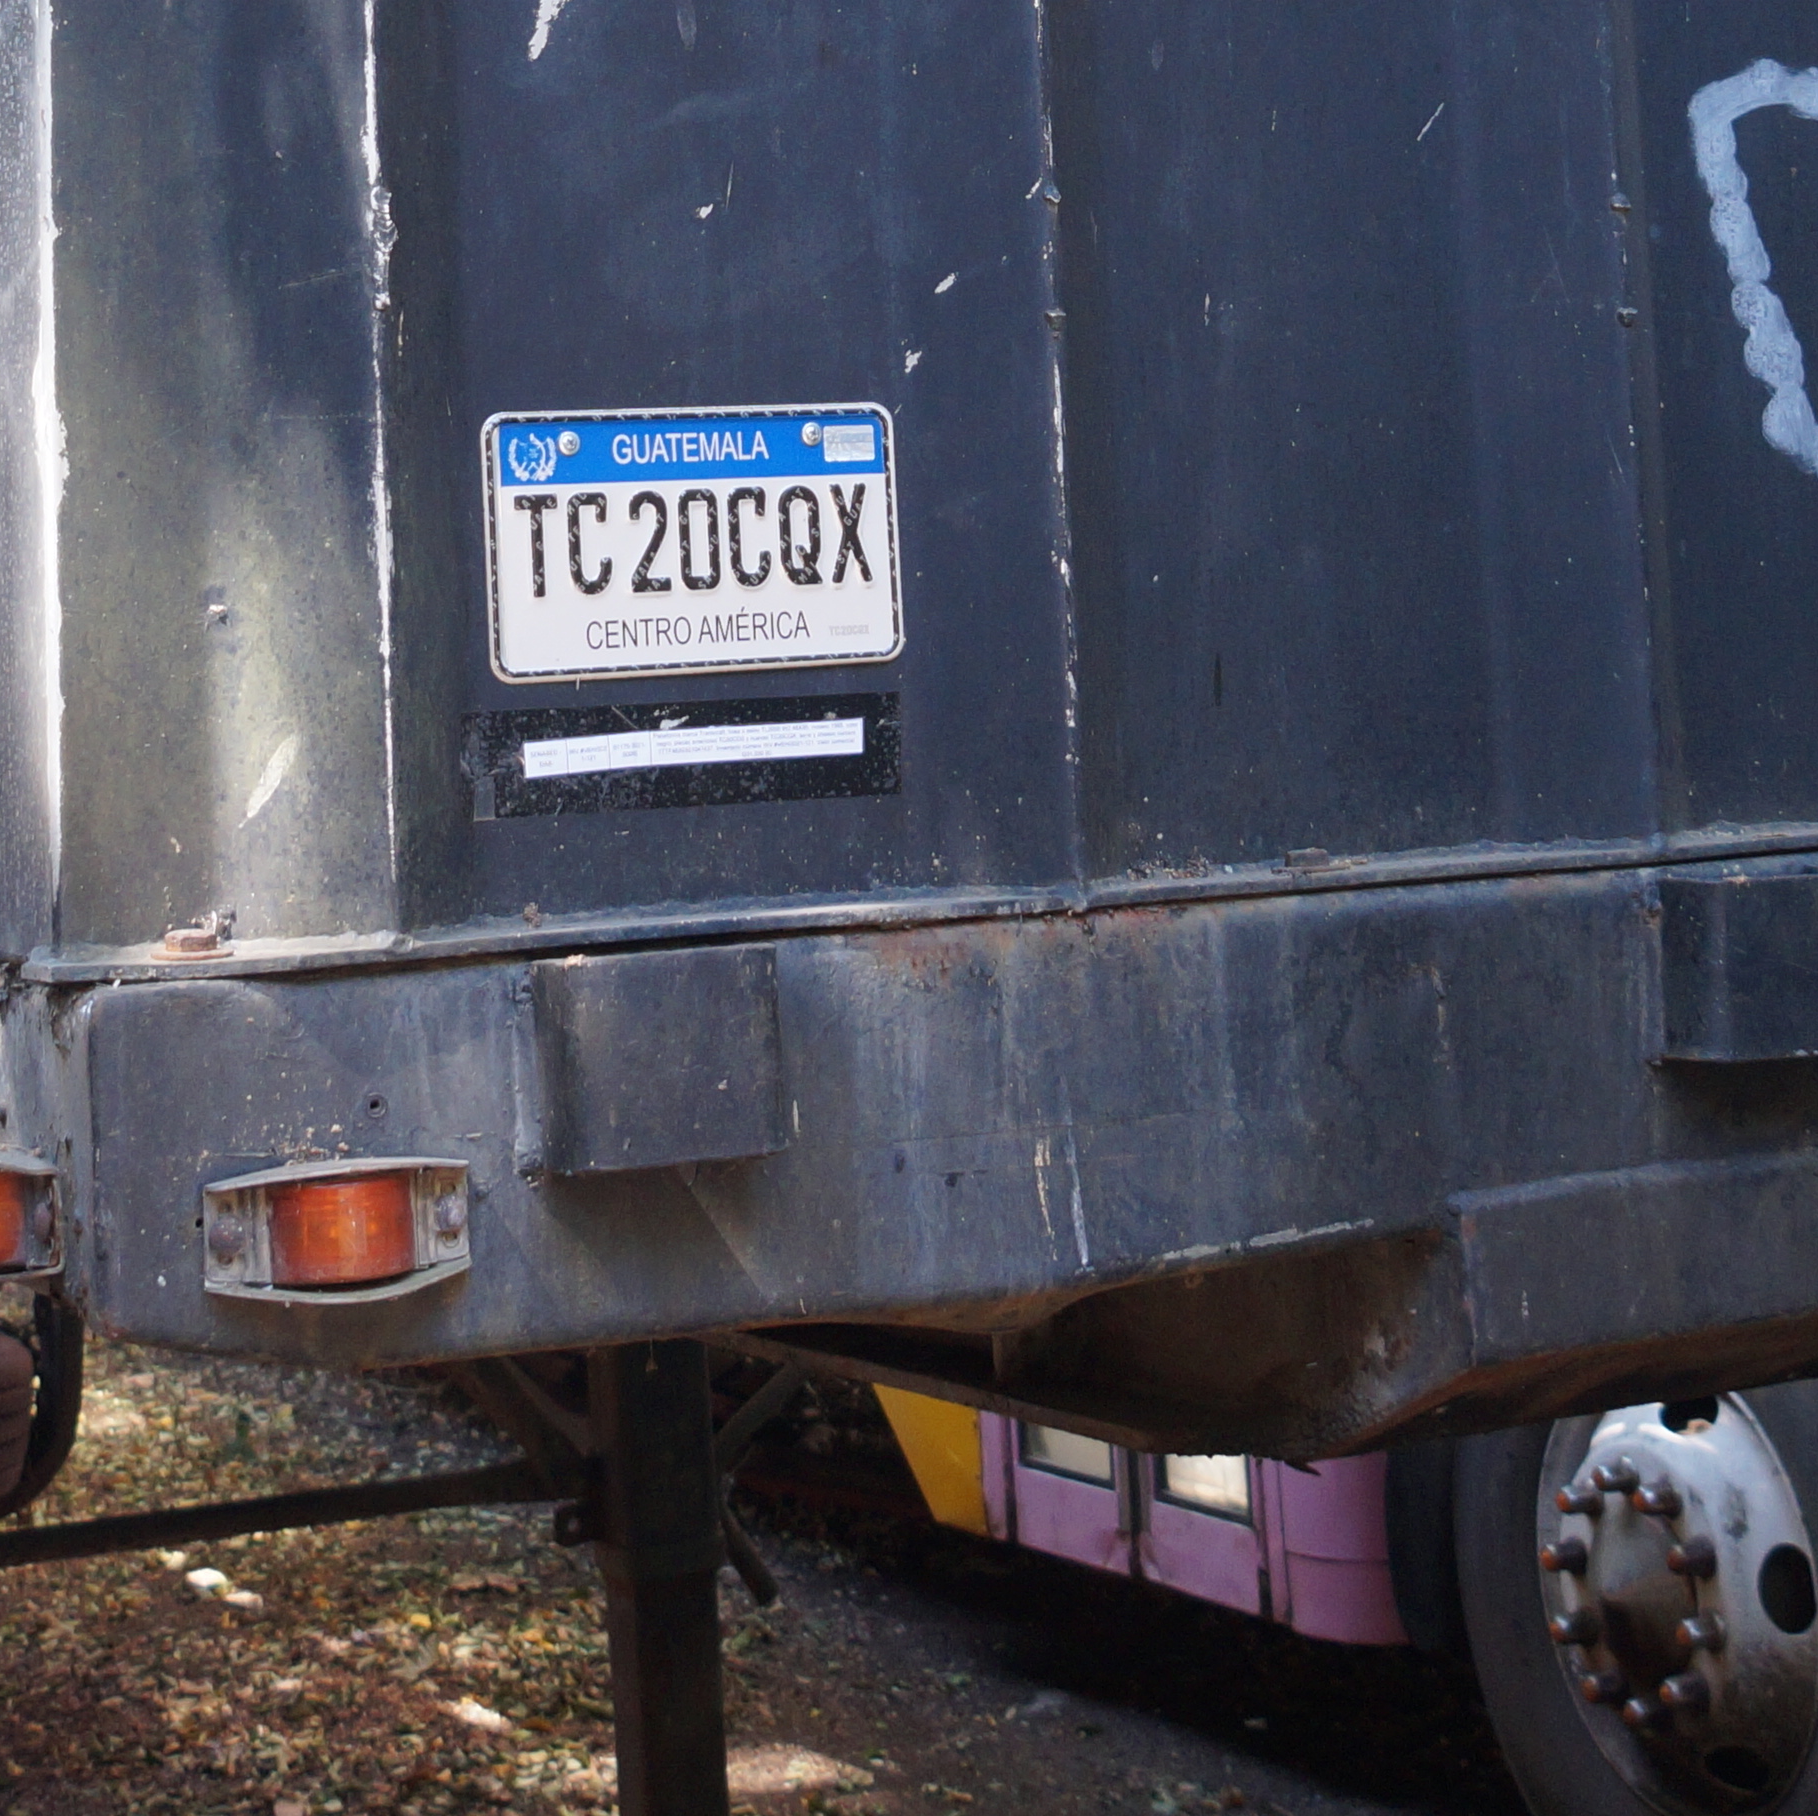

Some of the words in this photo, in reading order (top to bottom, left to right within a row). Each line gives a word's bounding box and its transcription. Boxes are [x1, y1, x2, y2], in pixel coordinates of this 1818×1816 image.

[612, 430, 769, 465] GUATEMALA
[585, 615, 692, 651] CENTRO
[698, 606, 811, 645] AMÉRICA
